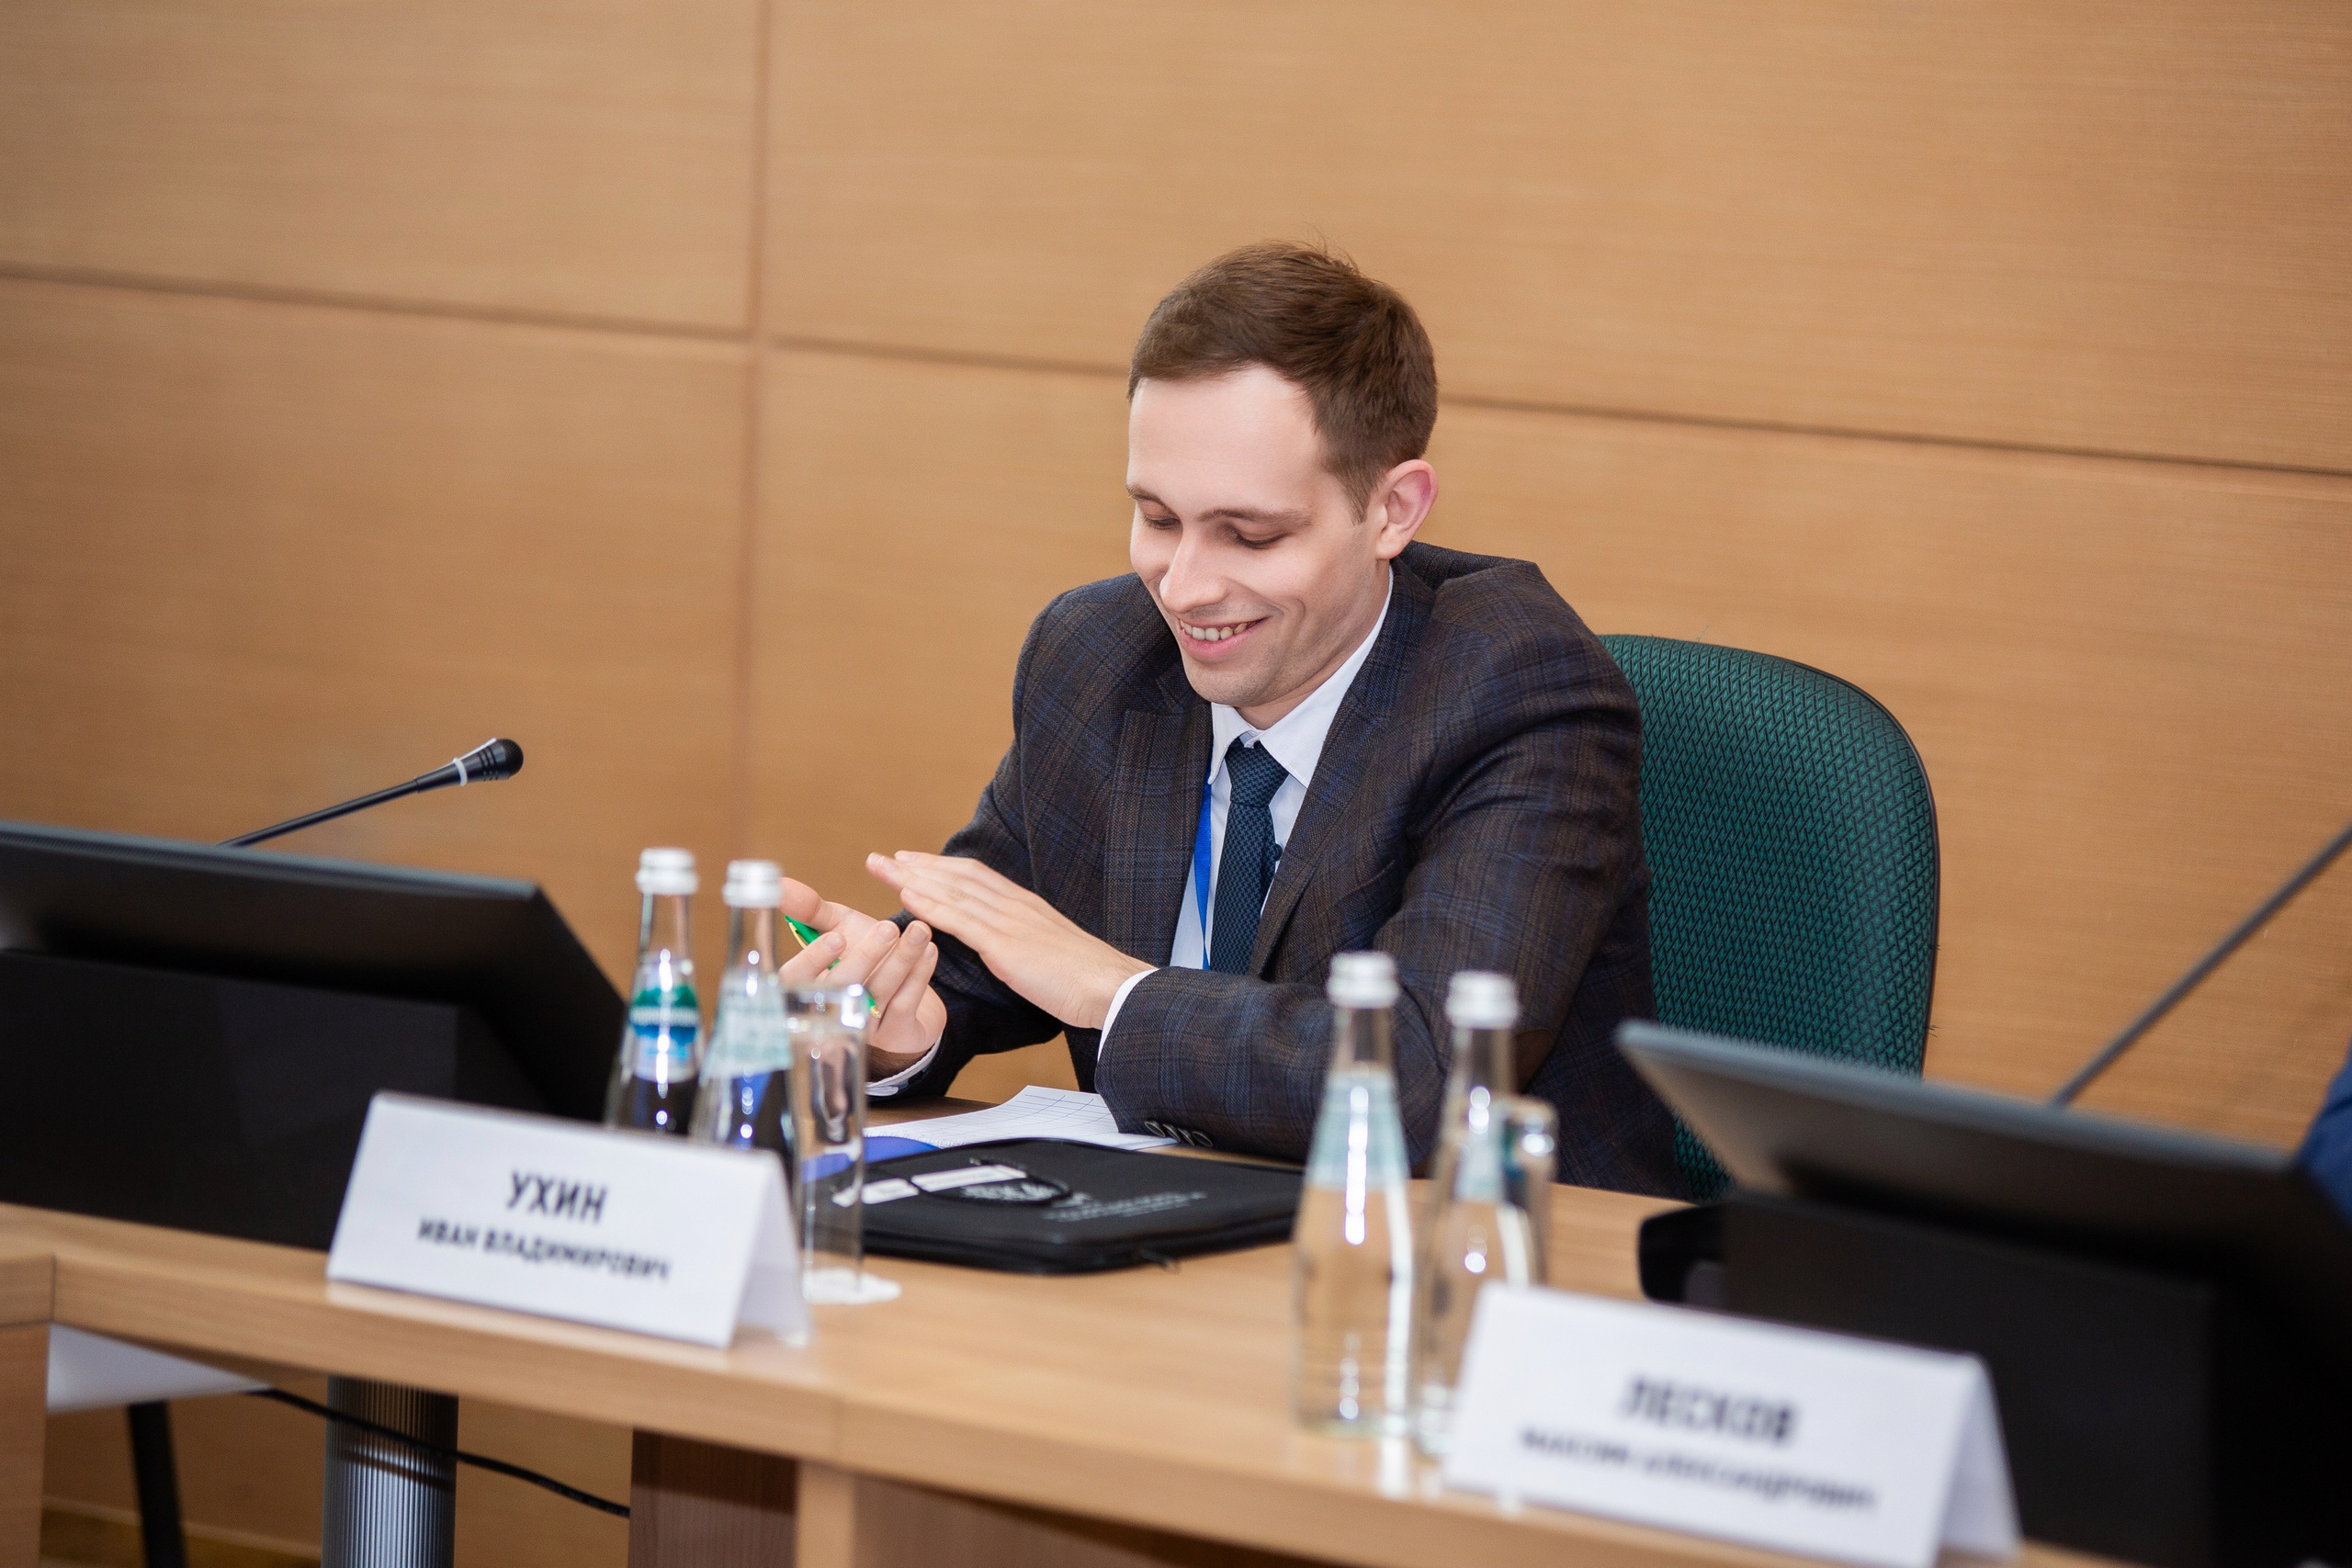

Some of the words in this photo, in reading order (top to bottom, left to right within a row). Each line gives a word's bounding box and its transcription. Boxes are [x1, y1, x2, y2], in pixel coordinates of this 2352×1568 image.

[505, 1171, 608, 1223] УХИН
[418, 1219, 478, 1245] ИВАН
[483, 1230, 670, 1278] ВЛАДИМИРОВИЧ
[1623, 1377, 1796, 1444] ЛЕСКОВ
